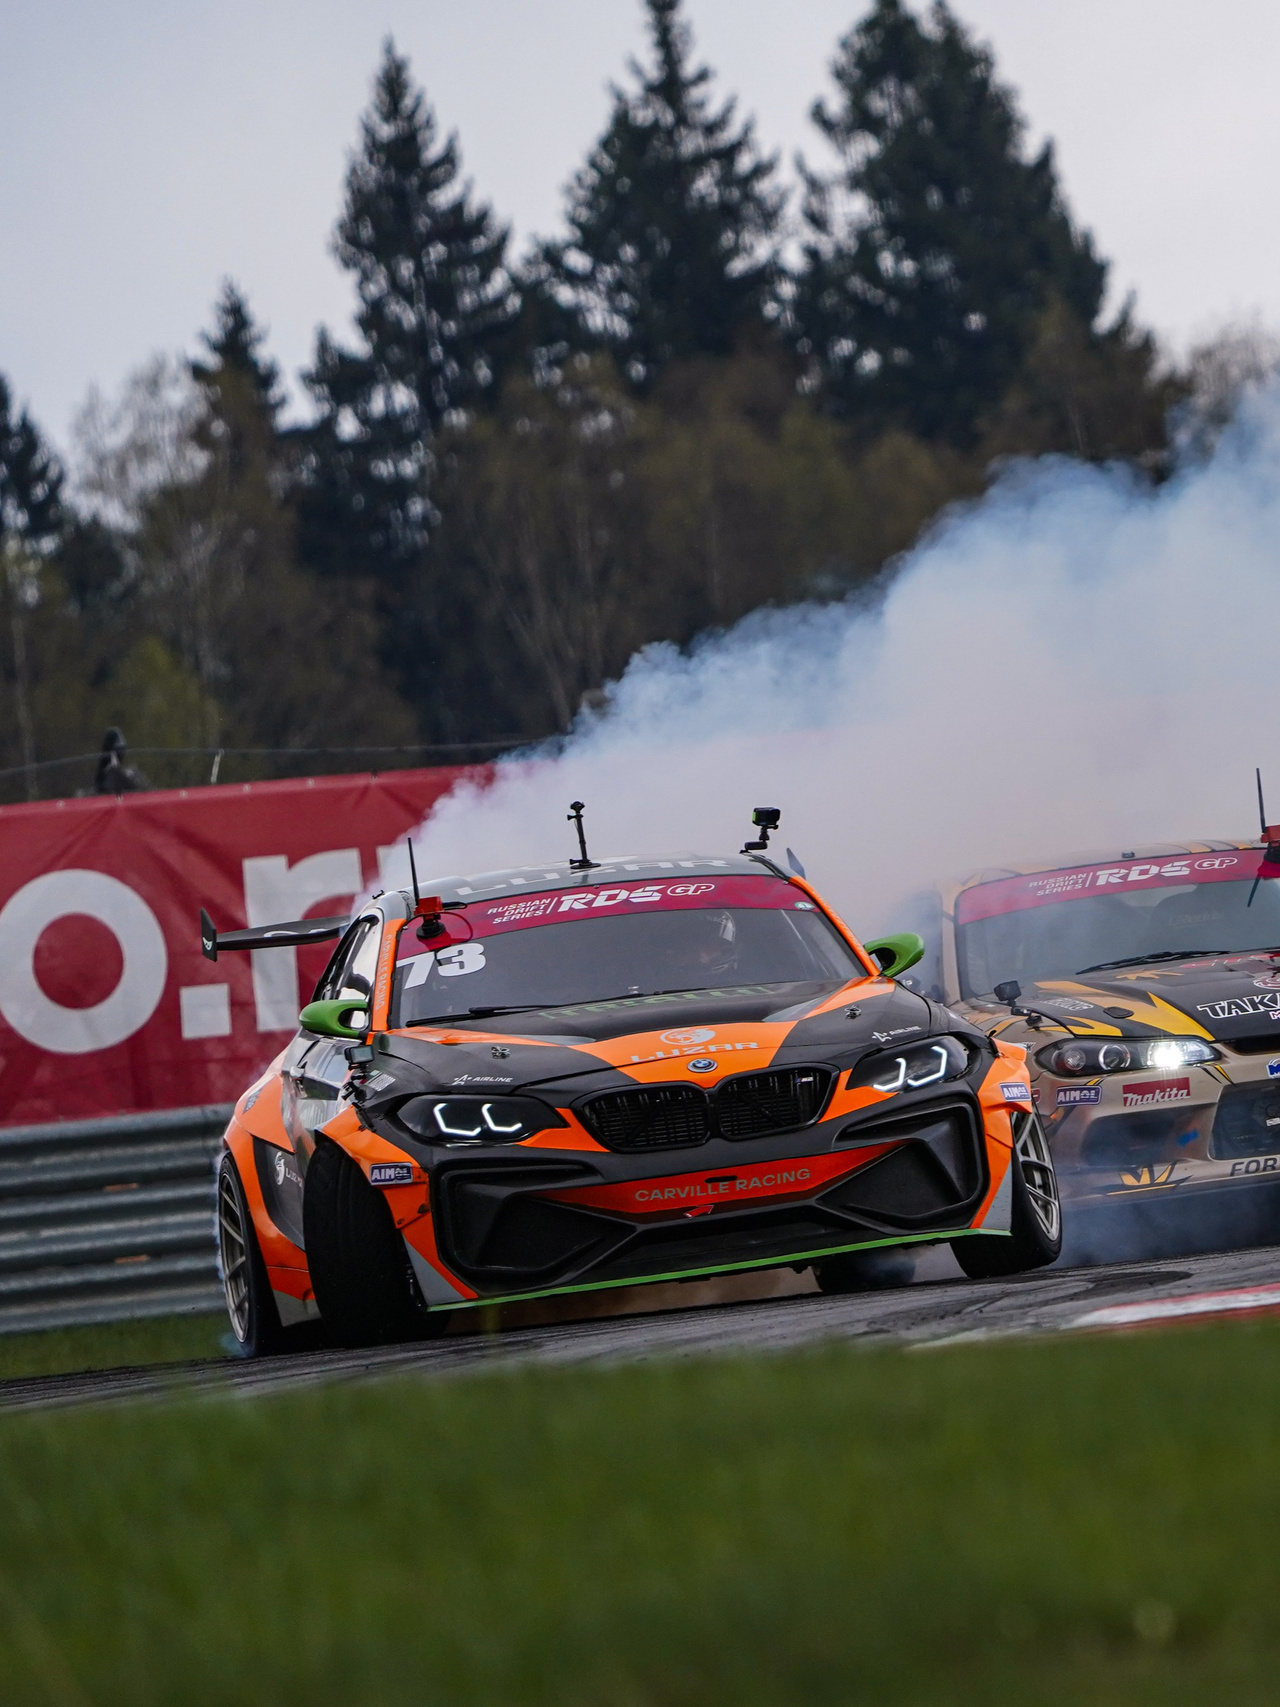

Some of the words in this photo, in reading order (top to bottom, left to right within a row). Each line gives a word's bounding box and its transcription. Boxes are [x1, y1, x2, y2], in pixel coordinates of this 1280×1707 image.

[1096, 861, 1193, 886] RDS
[1194, 858, 1238, 870] GP
[1029, 873, 1087, 888] RUSSIAN
[1046, 879, 1084, 889] DRIFT
[1036, 883, 1082, 896] SERIES
[558, 885, 665, 913] RDS
[667, 883, 715, 896] GP
[487, 898, 551, 915] RUSSIAN
[504, 904, 546, 917] DRIFT
[493, 909, 543, 924] SERIES
[396, 943, 486, 990] 73
[631, 1041, 759, 1063] LUZAR
[1057, 1089, 1098, 1103] AIMOL
[635, 1181, 730, 1202] CARVILLE
[736, 1168, 811, 1191] RACING
